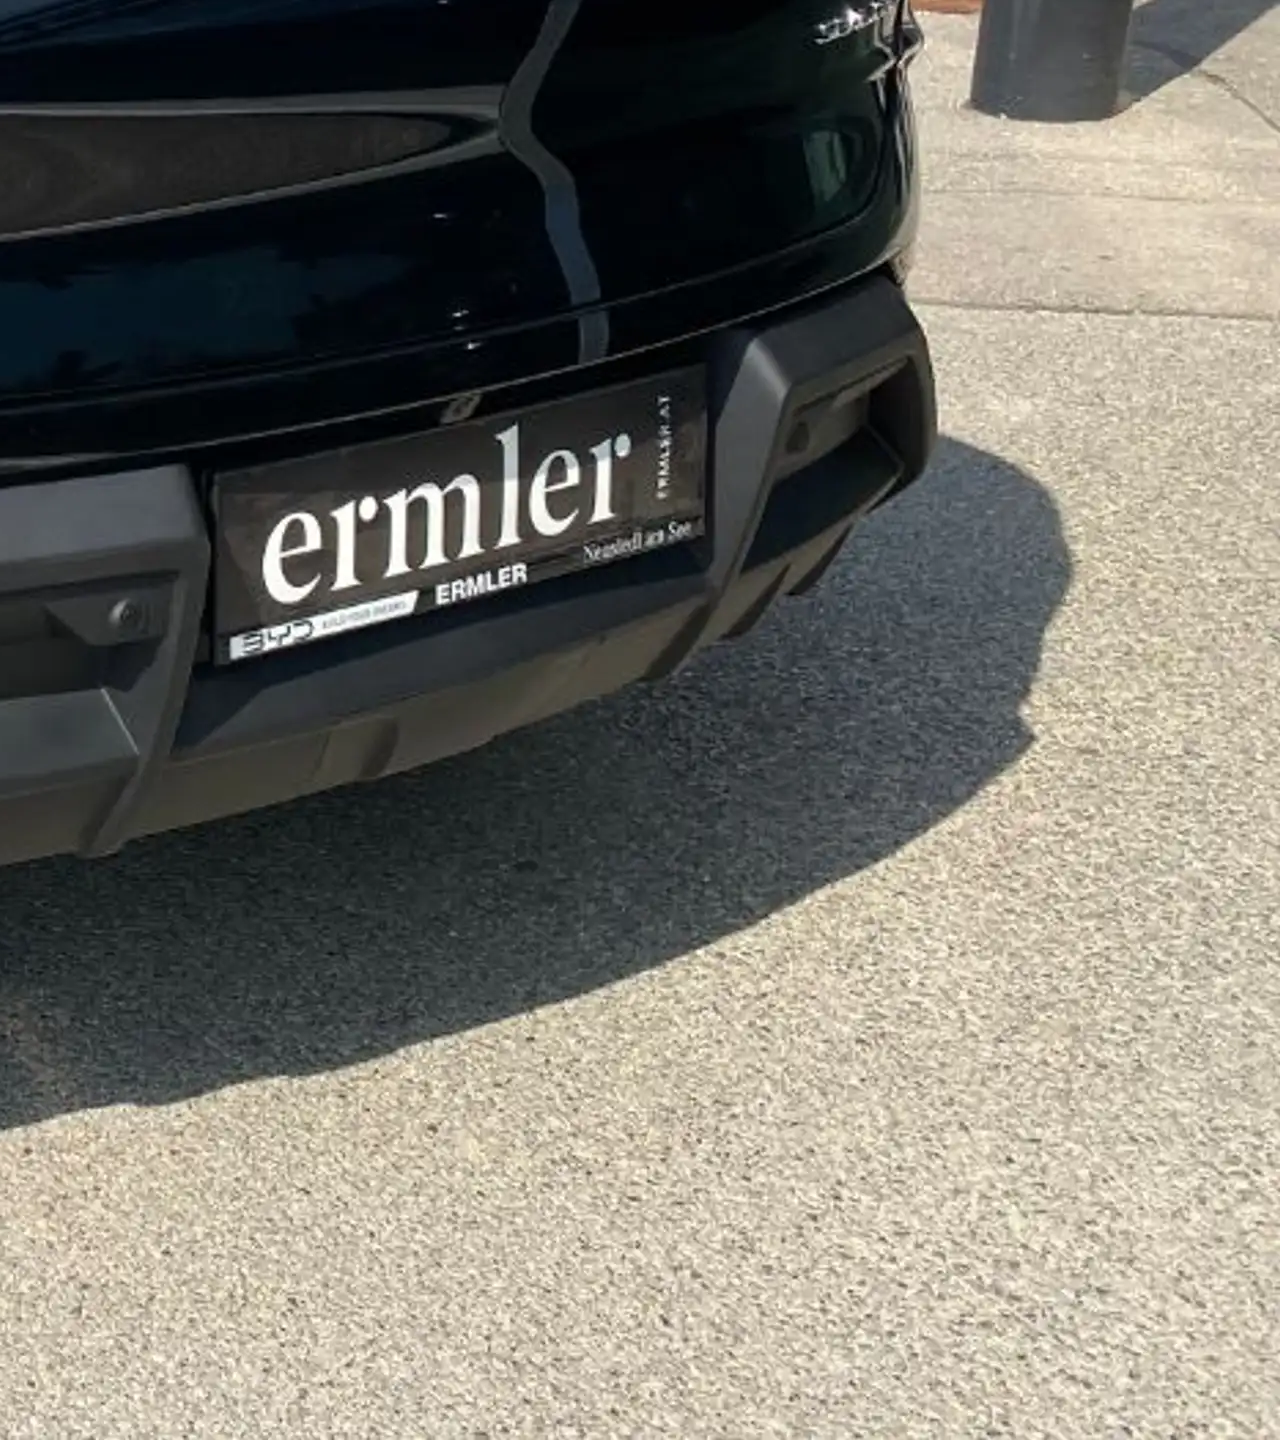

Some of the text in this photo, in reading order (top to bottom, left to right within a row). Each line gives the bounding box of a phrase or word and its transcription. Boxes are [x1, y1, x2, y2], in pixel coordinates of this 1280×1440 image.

[261, 422, 632, 605] ermler
[434, 562, 528, 606] ERMLER
[240, 619, 315, 654] BYD
